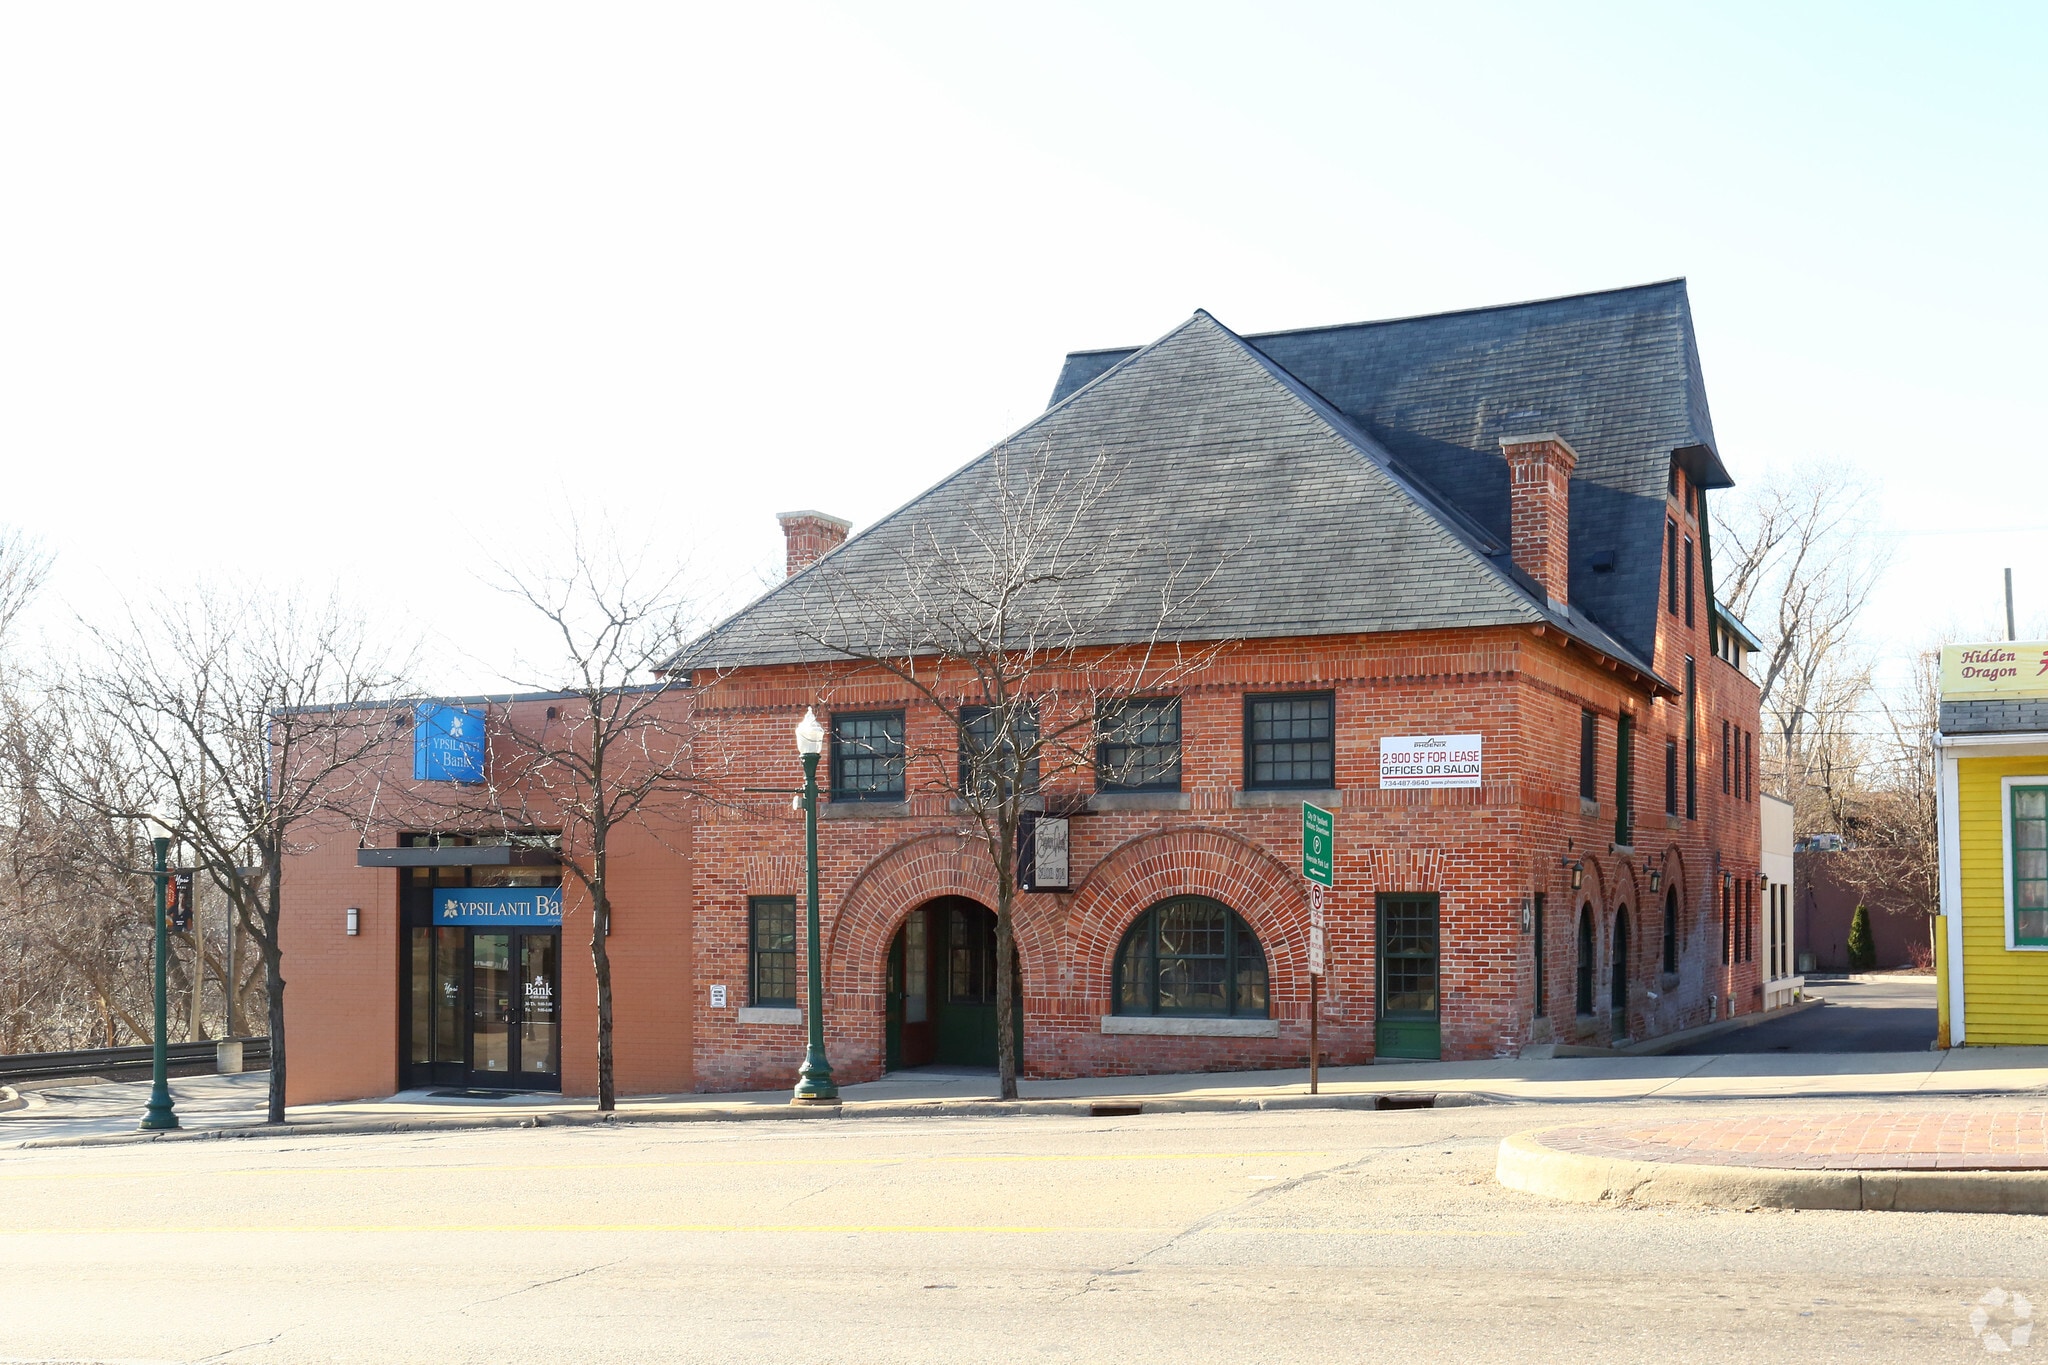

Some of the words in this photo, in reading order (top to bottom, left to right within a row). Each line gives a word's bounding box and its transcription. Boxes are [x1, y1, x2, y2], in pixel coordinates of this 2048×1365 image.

[1961, 648, 2016, 664] Hidden
[1961, 666, 2017, 682] Dragon
[433, 737, 480, 752] YPSILANTI
[1382, 752, 1411, 764] 2,900
[1413, 752, 1425, 763] SF
[1427, 751, 1447, 763] FOR
[1449, 750, 1479, 762] LEASE
[1381, 765, 1424, 775] OFFICES
[1425, 765, 1441, 774] OR
[1443, 764, 1480, 774] SALON
[460, 902, 531, 916] YPSILANTI
[535, 895, 562, 916] Ba
[525, 982, 553, 996] Bank
